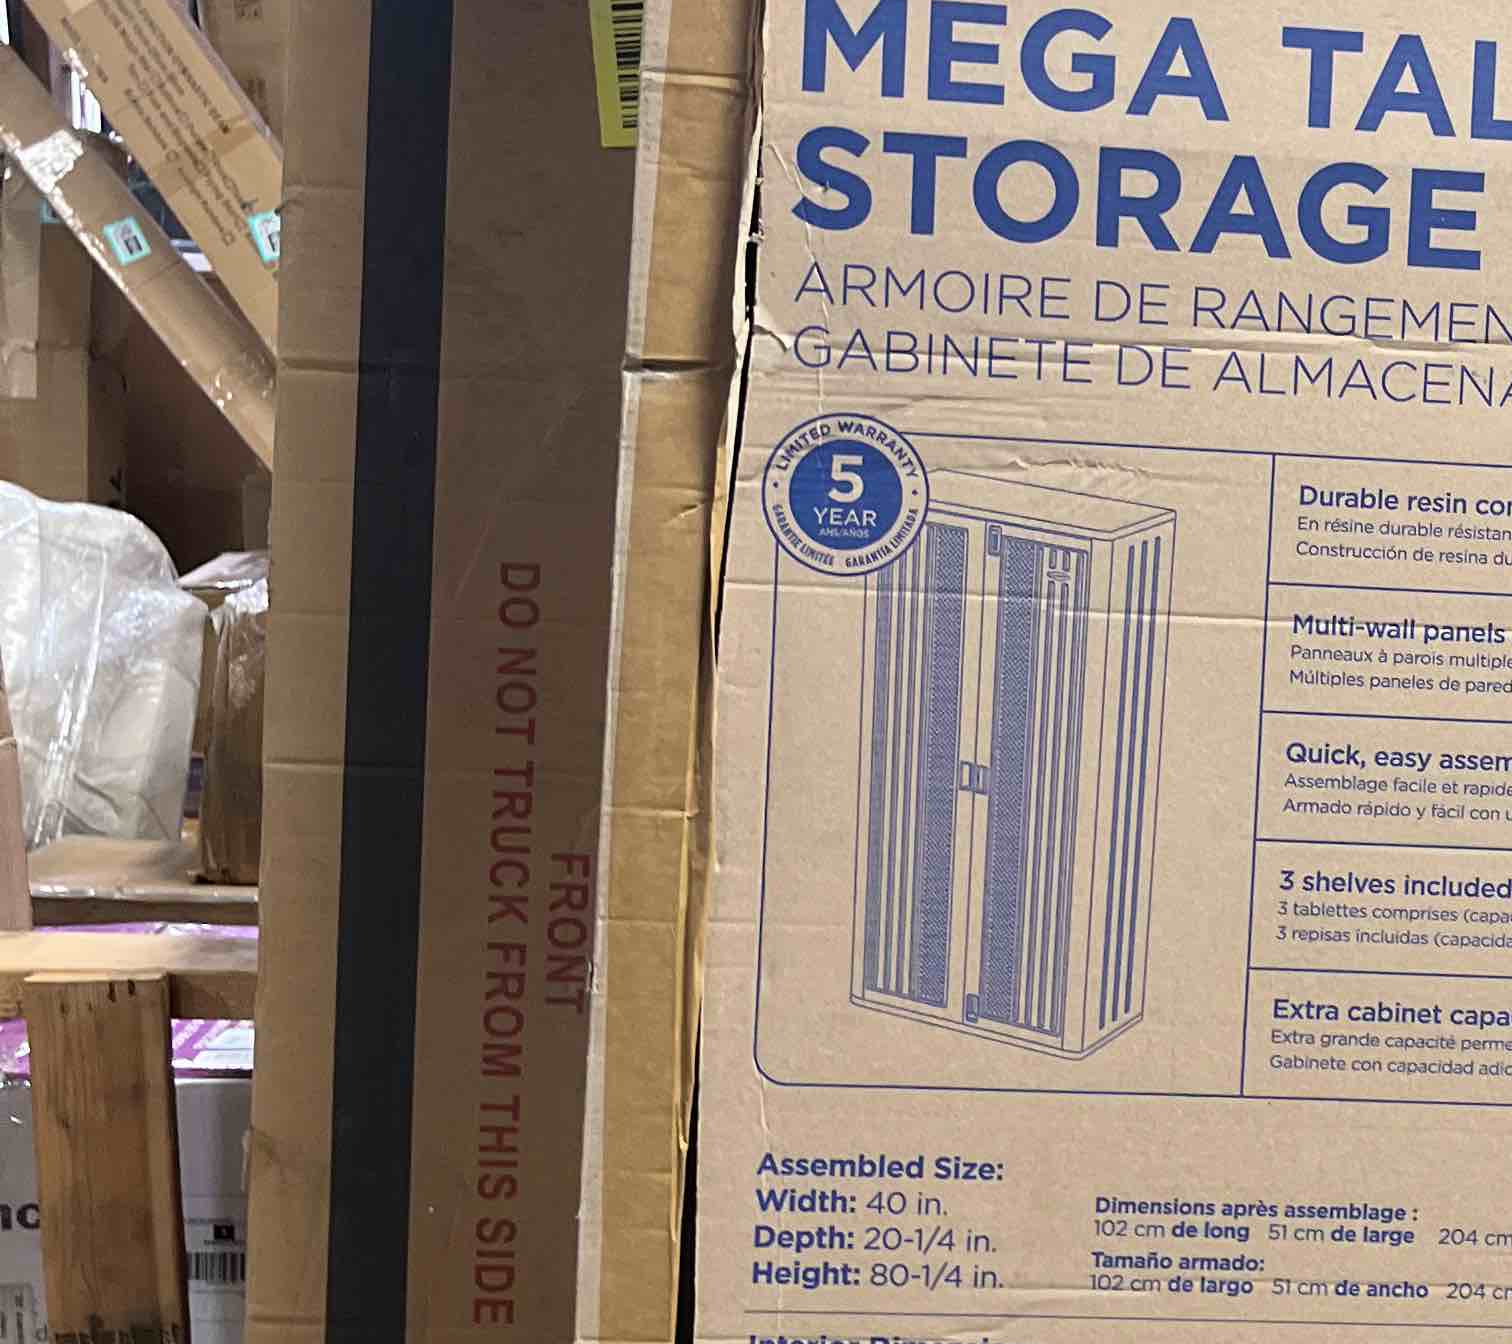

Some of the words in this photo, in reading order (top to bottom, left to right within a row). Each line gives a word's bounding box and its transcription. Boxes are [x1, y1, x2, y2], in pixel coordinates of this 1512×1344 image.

[792, 126, 1485, 270] STORAGE
[795, 261, 1071, 319] ARMOIRE
[1095, 280, 1169, 325] DE
[794, 326, 1093, 383] GABINETE
[1117, 342, 1194, 389] DE
[776, 424, 831, 471] LIMITED
[838, 420, 918, 478] WARRANTY
[828, 454, 864, 503] 5
[1300, 485, 1398, 510] Durable
[1408, 493, 1466, 514] resin
[813, 507, 877, 527] YEAR
[1298, 516, 1318, 530] En
[1325, 518, 1374, 534] résine
[1379, 521, 1442, 537] durable
[496, 562, 540, 630] DO
[1294, 614, 1415, 639] Multi-wall
[1424, 623, 1506, 644] panels
[493, 645, 538, 745] NOT
[1287, 743, 1365, 769] Quick,
[1375, 751, 1432, 772] easy
[487, 759, 535, 925] TRUCK
[1280, 870, 1294, 890] 3
[1302, 871, 1395, 894] shelves
[1405, 875, 1512, 898] included
[546, 851, 590, 1015] FRONT
[483, 942, 529, 1082] FROM
[1274, 999, 1338, 1020] Extra
[1348, 1002, 1442, 1024] cabinet
[1270, 1055, 1346, 1070] Gabinete
[1352, 1060, 1382, 1072] con
[1387, 1060, 1474, 1075] capacidad
[477, 1097, 521, 1201] THIS
[757, 1153, 924, 1178] Assembled
[934, 1156, 1003, 1180] Size:
[756, 1189, 856, 1213] Width:
[866, 1192, 906, 1214] 40
[918, 1192, 947, 1215] in.
[1096, 1197, 1215, 1215] Dimensions
[1222, 1200, 1278, 1219] après
[1285, 1203, 1406, 1223] assemblage
[754, 1225, 853, 1253] Depth:
[864, 1226, 955, 1254] 20-1/4
[967, 1230, 996, 1252] in.
[473, 1213, 517, 1327] SIDE
[753, 1261, 860, 1289] Height:
[870, 1262, 962, 1290] 80-1/4
[974, 1265, 1003, 1288] in.
[1091, 1252, 1172, 1269] Tamaño
[1179, 1254, 1264, 1271] armado:
